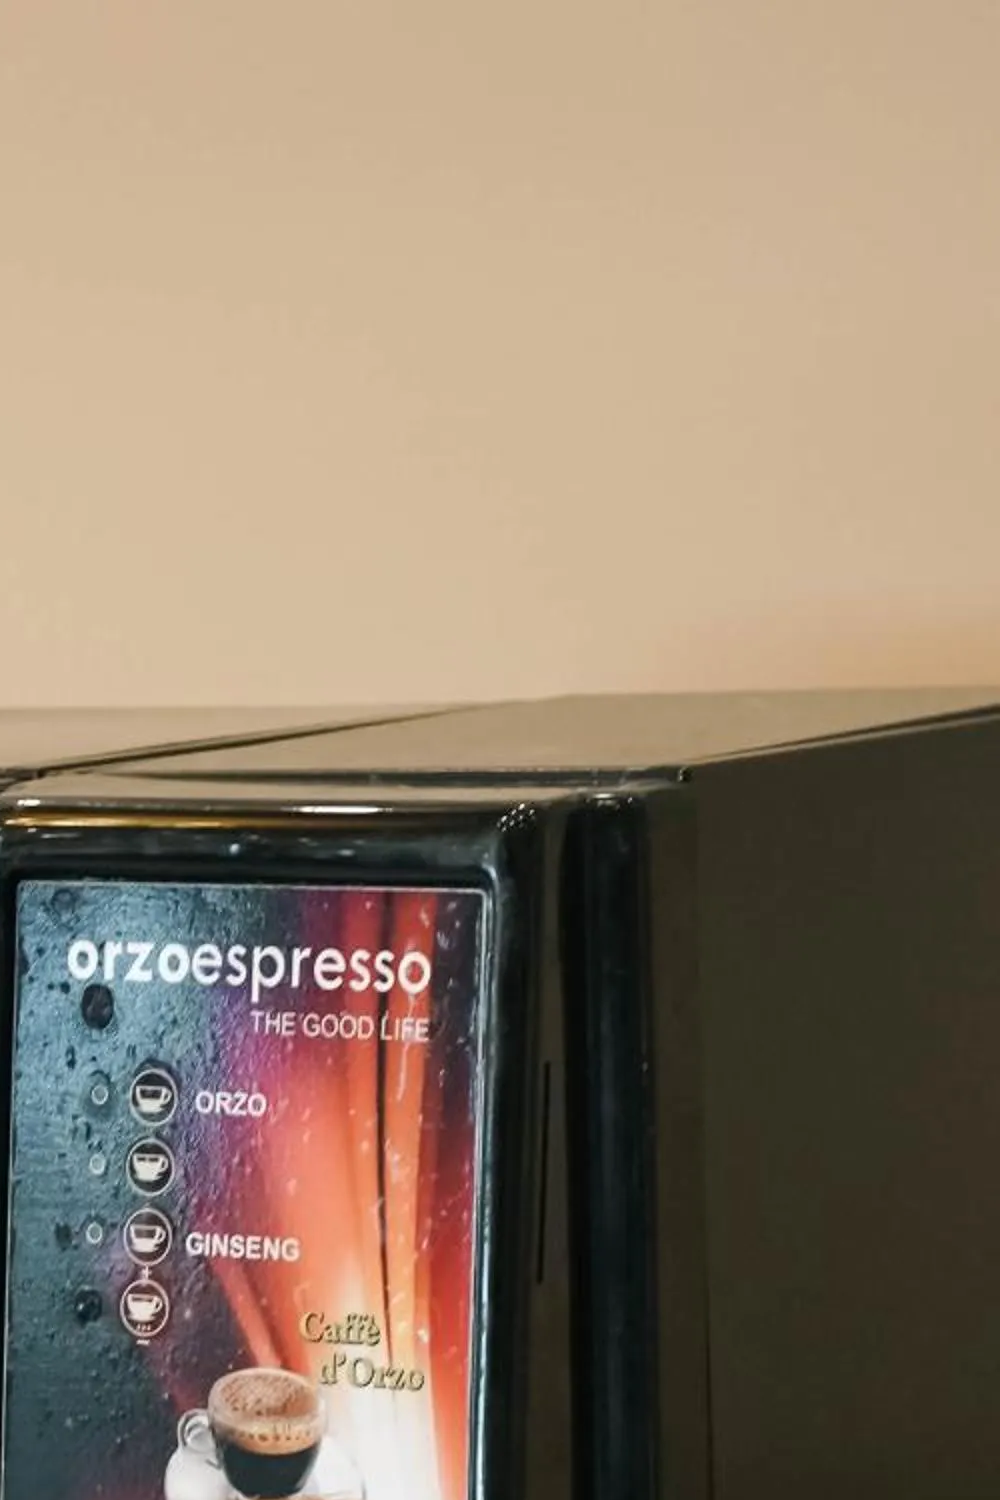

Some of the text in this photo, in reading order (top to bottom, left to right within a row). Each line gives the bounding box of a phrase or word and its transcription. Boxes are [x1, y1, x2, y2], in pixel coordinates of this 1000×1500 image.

[67, 939, 432, 1003] orzoespresso
[250, 1010, 430, 1041] THE GOOD LIFE
[195, 1090, 267, 1116] ORZO
[185, 1232, 301, 1261] GINSENG
